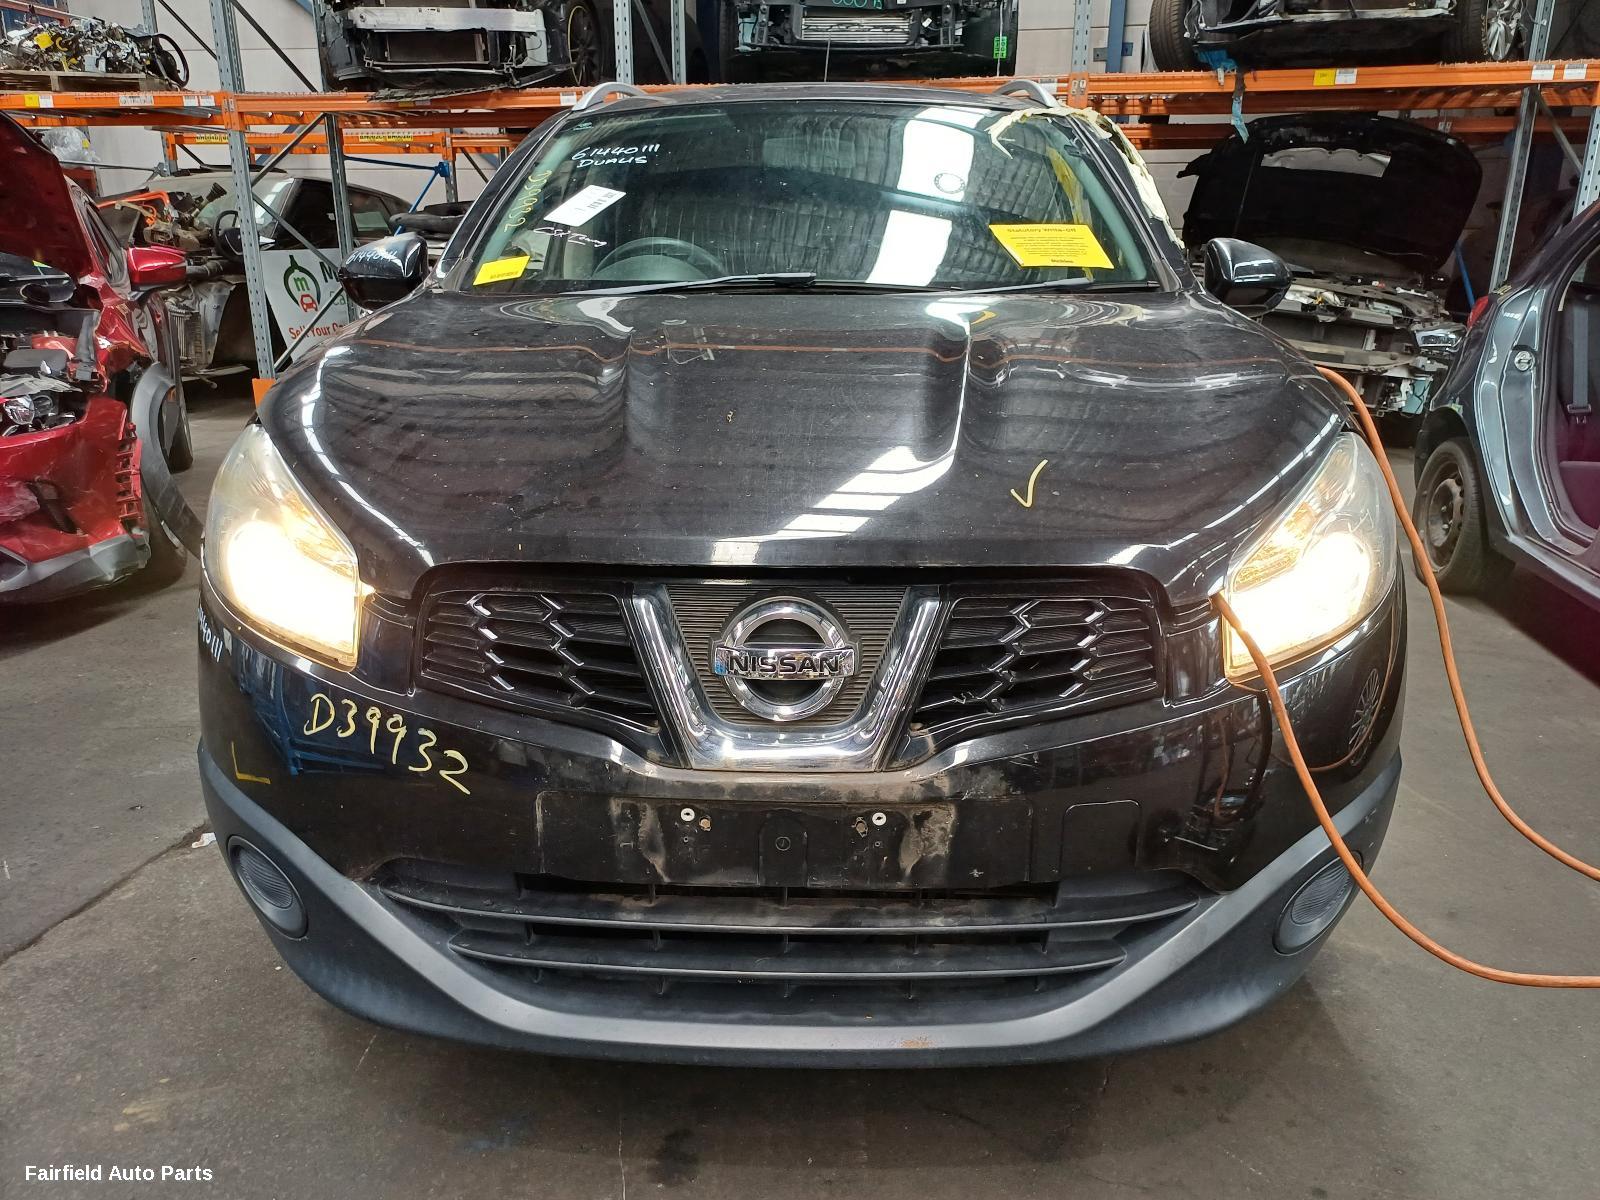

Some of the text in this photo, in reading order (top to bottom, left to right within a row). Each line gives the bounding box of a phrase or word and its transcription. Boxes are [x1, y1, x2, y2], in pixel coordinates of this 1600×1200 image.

[571, 143, 661, 160] 61440111
[728, 654, 840, 673] NISSAN
[303, 692, 471, 795] D39932
